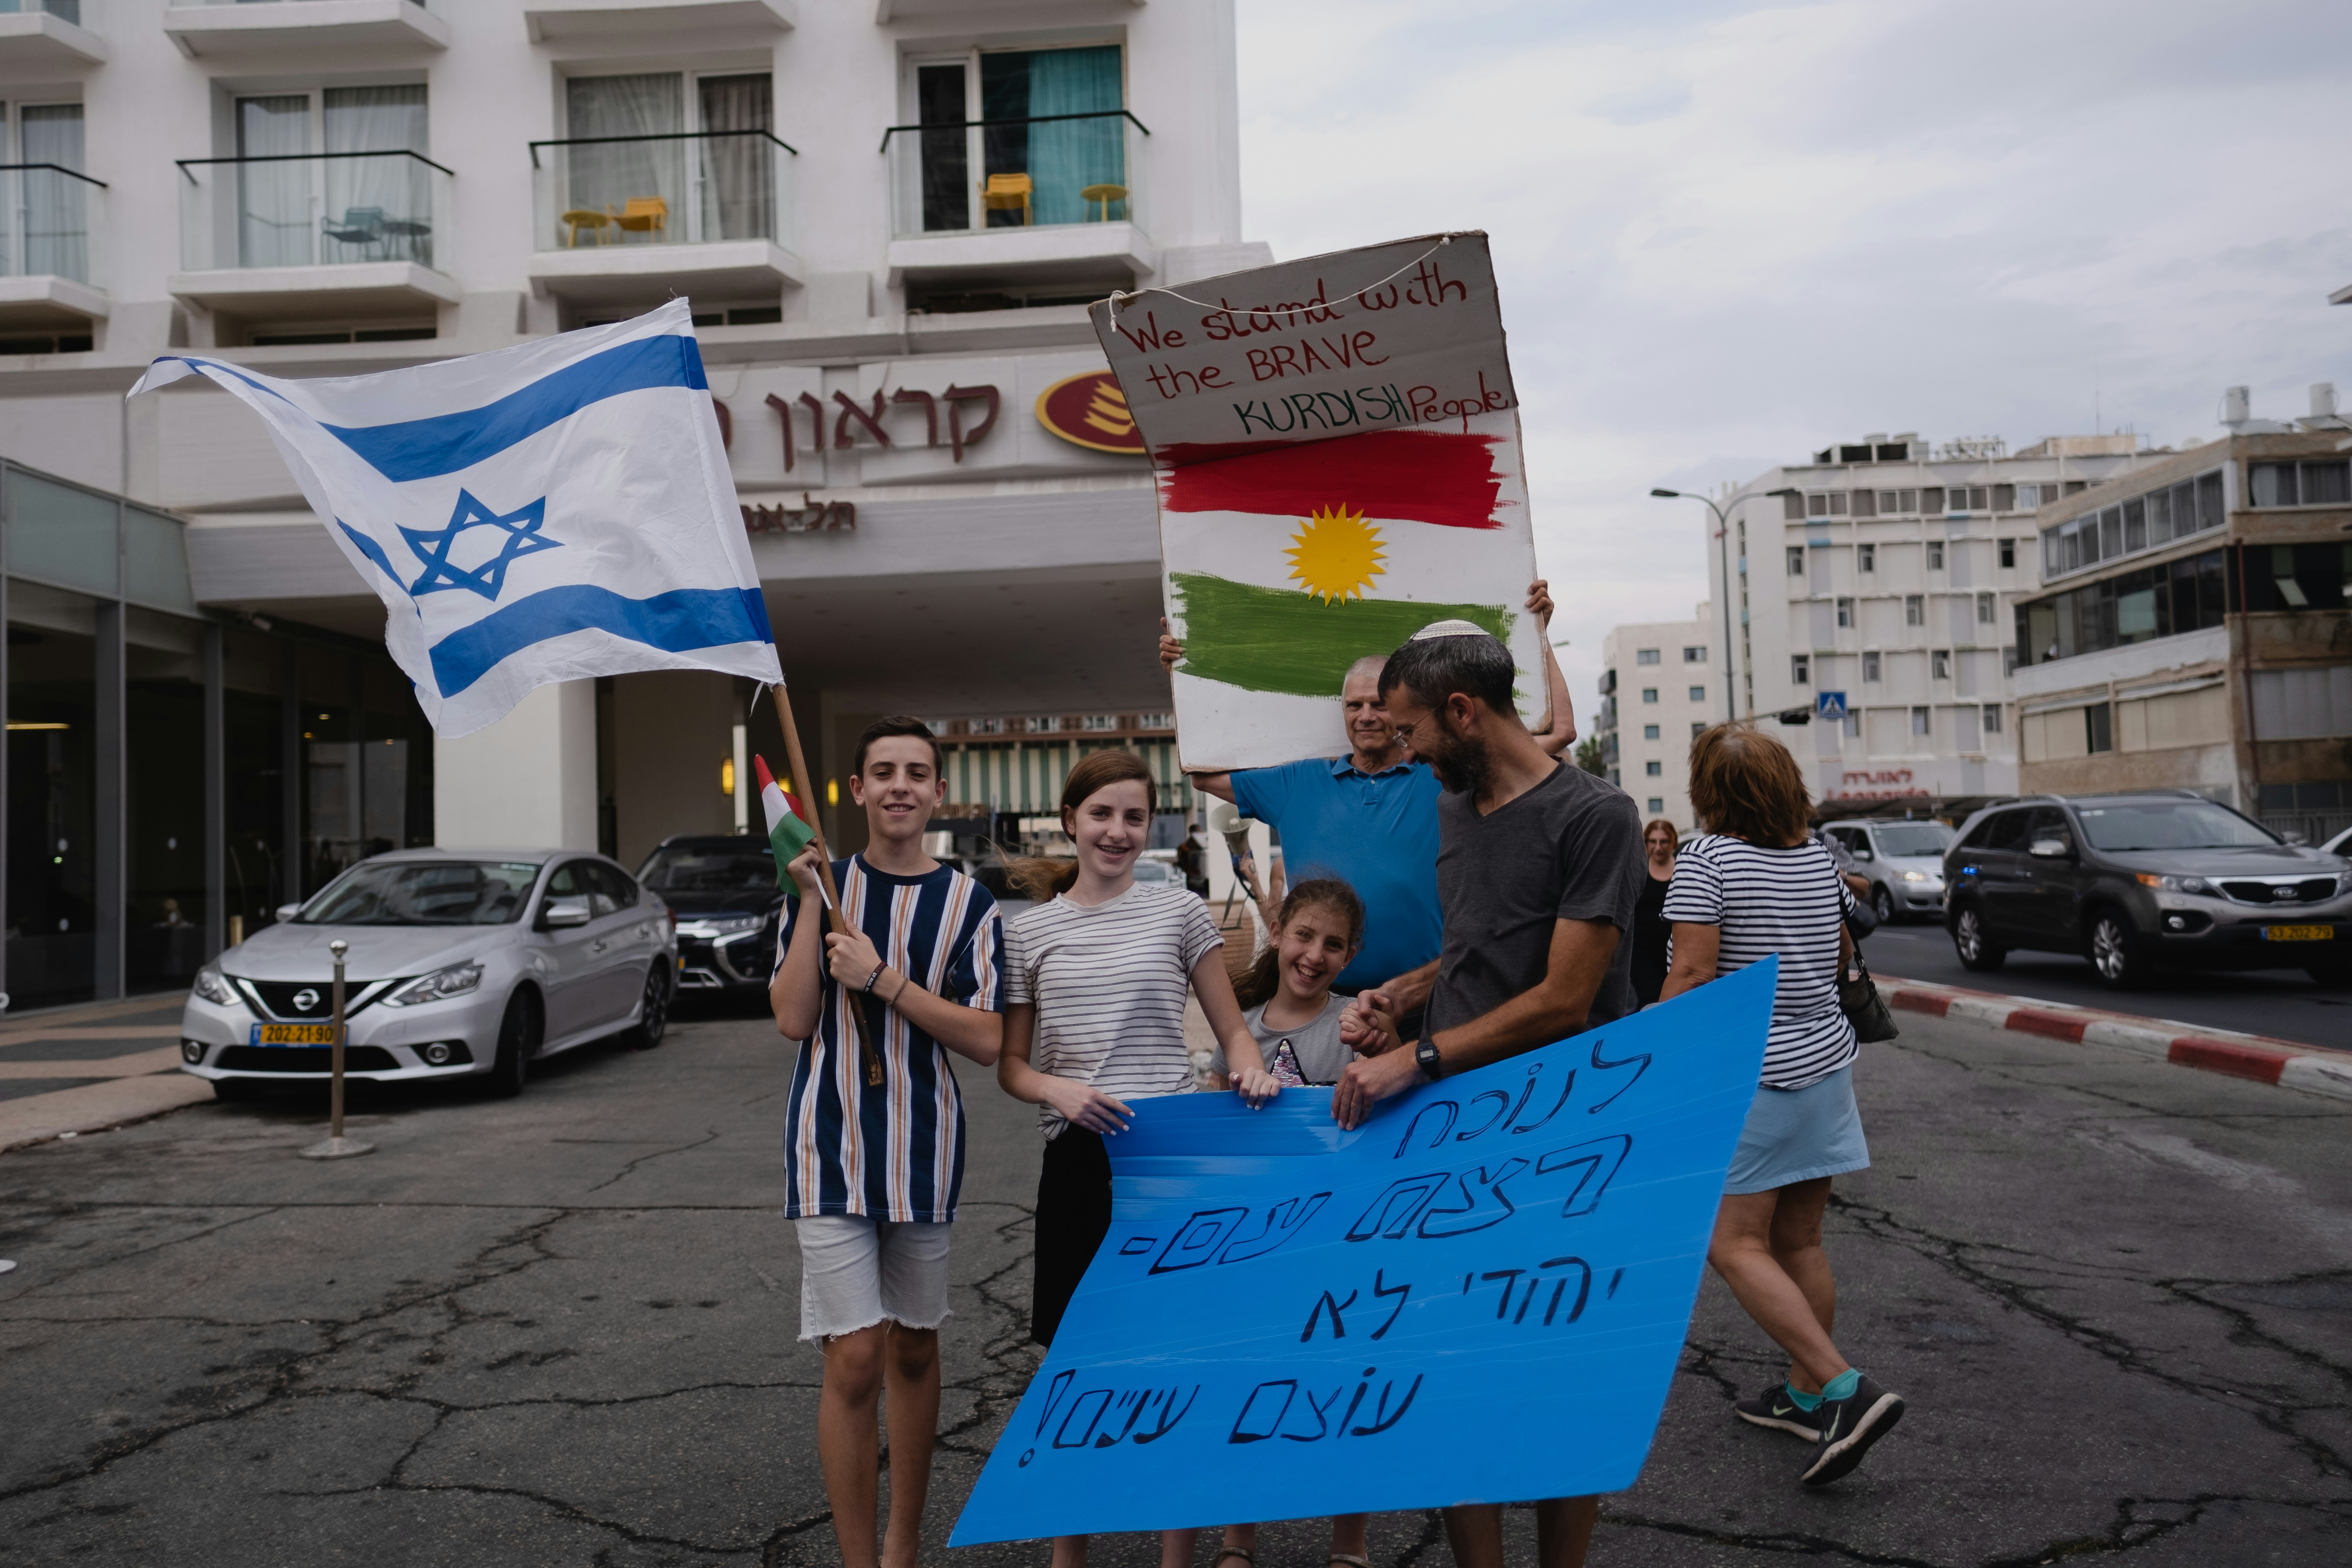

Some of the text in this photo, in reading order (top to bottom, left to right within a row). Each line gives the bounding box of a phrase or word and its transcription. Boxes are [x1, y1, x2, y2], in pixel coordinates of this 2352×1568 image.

[1114, 260, 1467, 352] We stand with
[1146, 364, 1235, 399] the
[1233, 370, 1508, 435] KURDISH People
[764, 383, 1000, 473] קראון
[1344, 1134, 1632, 1243] רצח
[1300, 1256, 1625, 1343] יהודי לא
